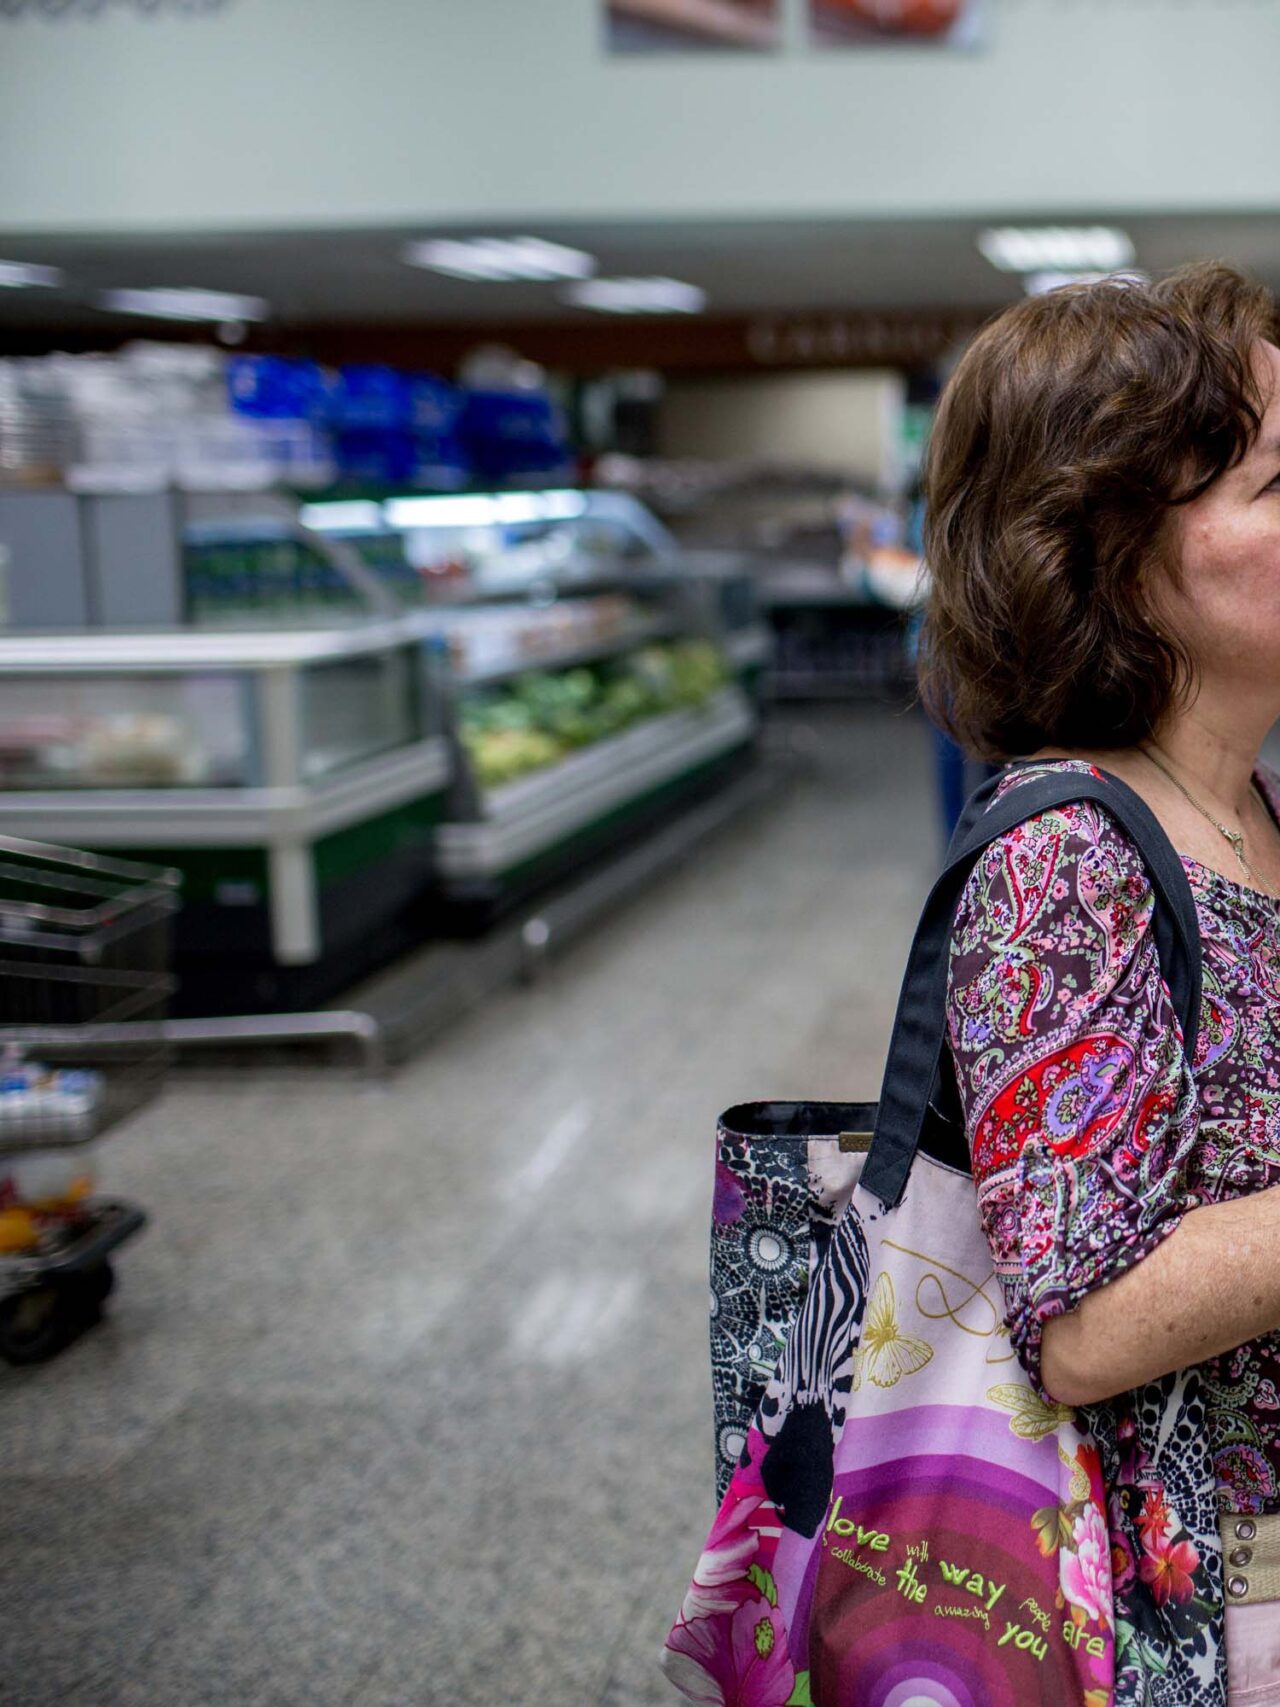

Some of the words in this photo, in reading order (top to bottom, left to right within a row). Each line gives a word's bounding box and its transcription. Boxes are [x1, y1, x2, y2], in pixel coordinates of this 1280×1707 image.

[826, 1496, 890, 1552] love
[896, 1559, 928, 1603] the
[939, 1560, 1006, 1611] way
[997, 1621, 1048, 1661] you
[1063, 1619, 1105, 1659] are
[831, 1546, 886, 1586] collaborate
[934, 1604, 990, 1631] amazing
[1018, 1597, 1051, 1632] people
